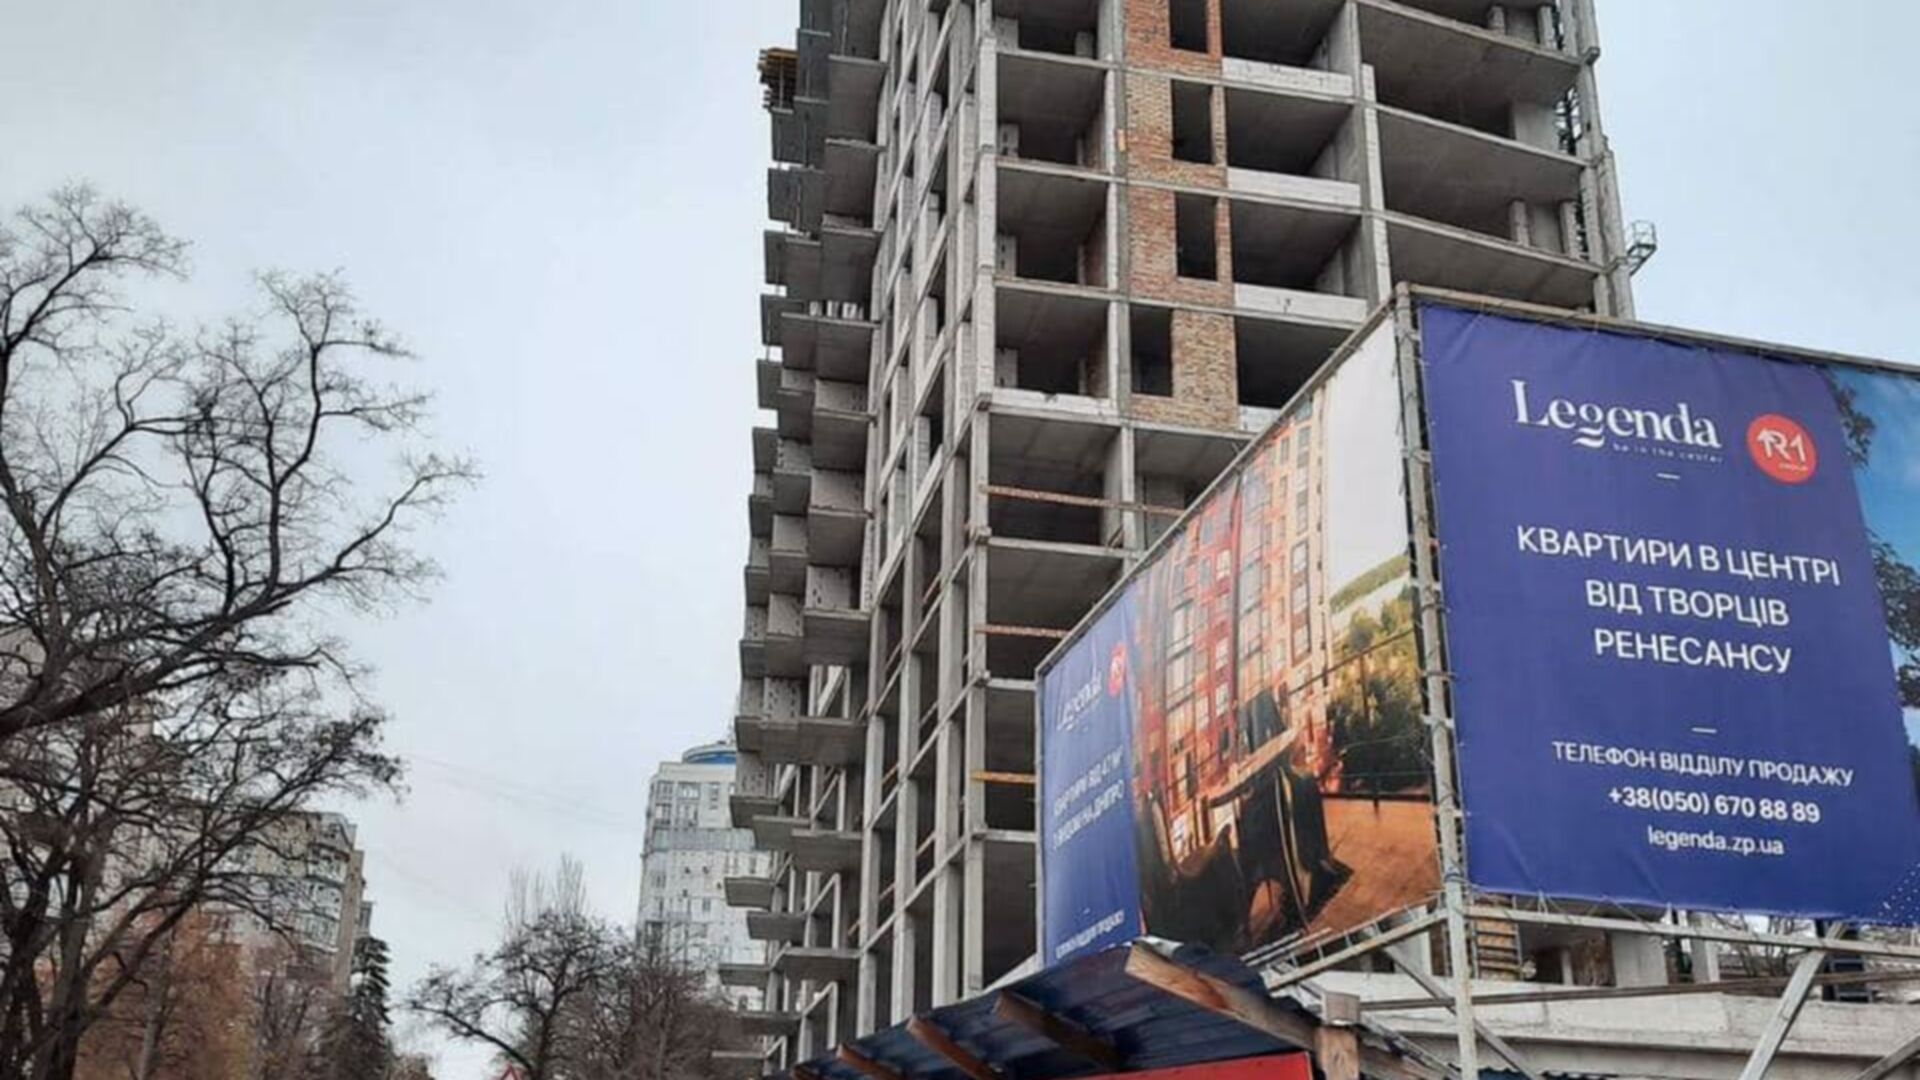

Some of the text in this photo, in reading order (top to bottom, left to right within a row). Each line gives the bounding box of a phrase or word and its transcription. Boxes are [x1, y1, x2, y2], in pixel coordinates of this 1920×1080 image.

[1510, 379, 1722, 448] Legenda
[1517, 525, 1841, 586] КВАРТИРИ В ЦЕНТРІ
[1585, 579, 1790, 627] ВІД ТВОРЦІВ
[1594, 628, 1791, 674] РЕНЕСАНСУ
[1552, 741, 1854, 788] ТЕЛЕФОН ВІДДІЛУ ПРОДАЖУ
[1608, 786, 1821, 823] +38(050) 670 88 89
[1647, 825, 1785, 856] legenda.zp.ua
